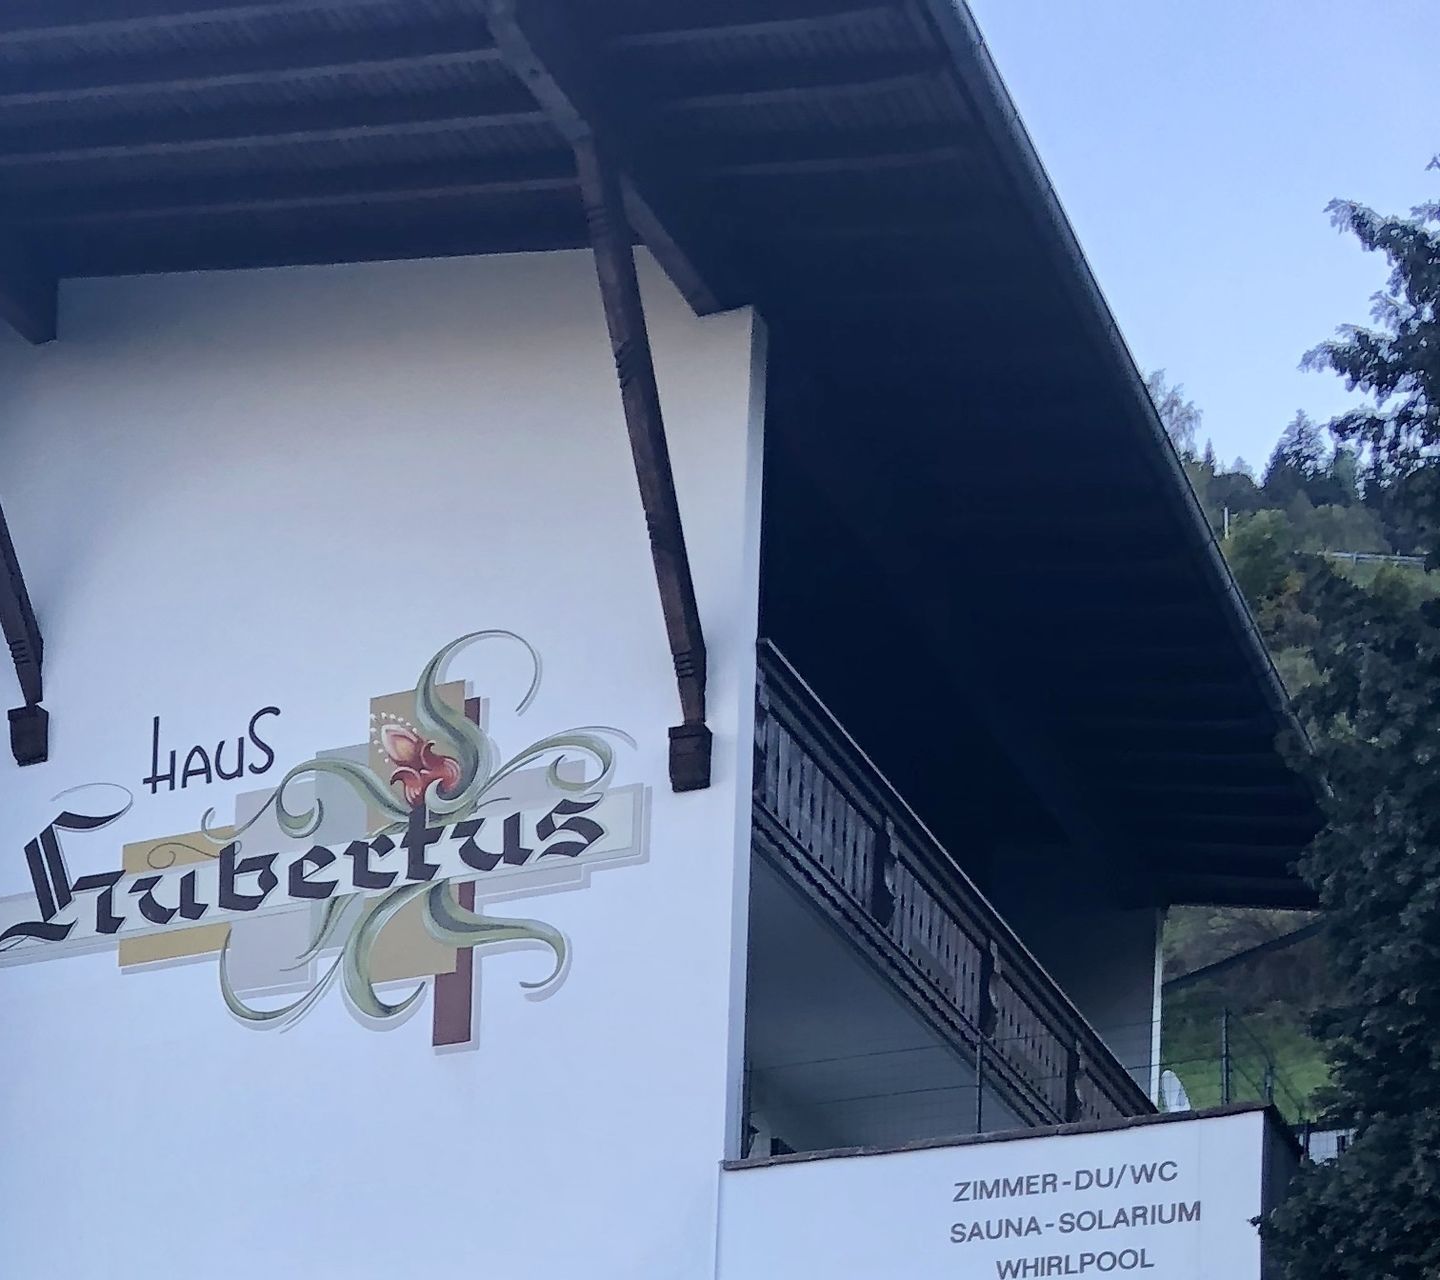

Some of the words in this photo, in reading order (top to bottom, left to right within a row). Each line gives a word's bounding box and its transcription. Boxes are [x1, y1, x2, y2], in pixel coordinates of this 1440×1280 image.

[143, 706, 281, 794] HAUS
[953, 1161, 1178, 1202] ZIMMER-DU/WC
[950, 1201, 1201, 1243] SAUNA-SOLARIUM
[996, 1248, 1154, 1280] WHIRLPOOL
